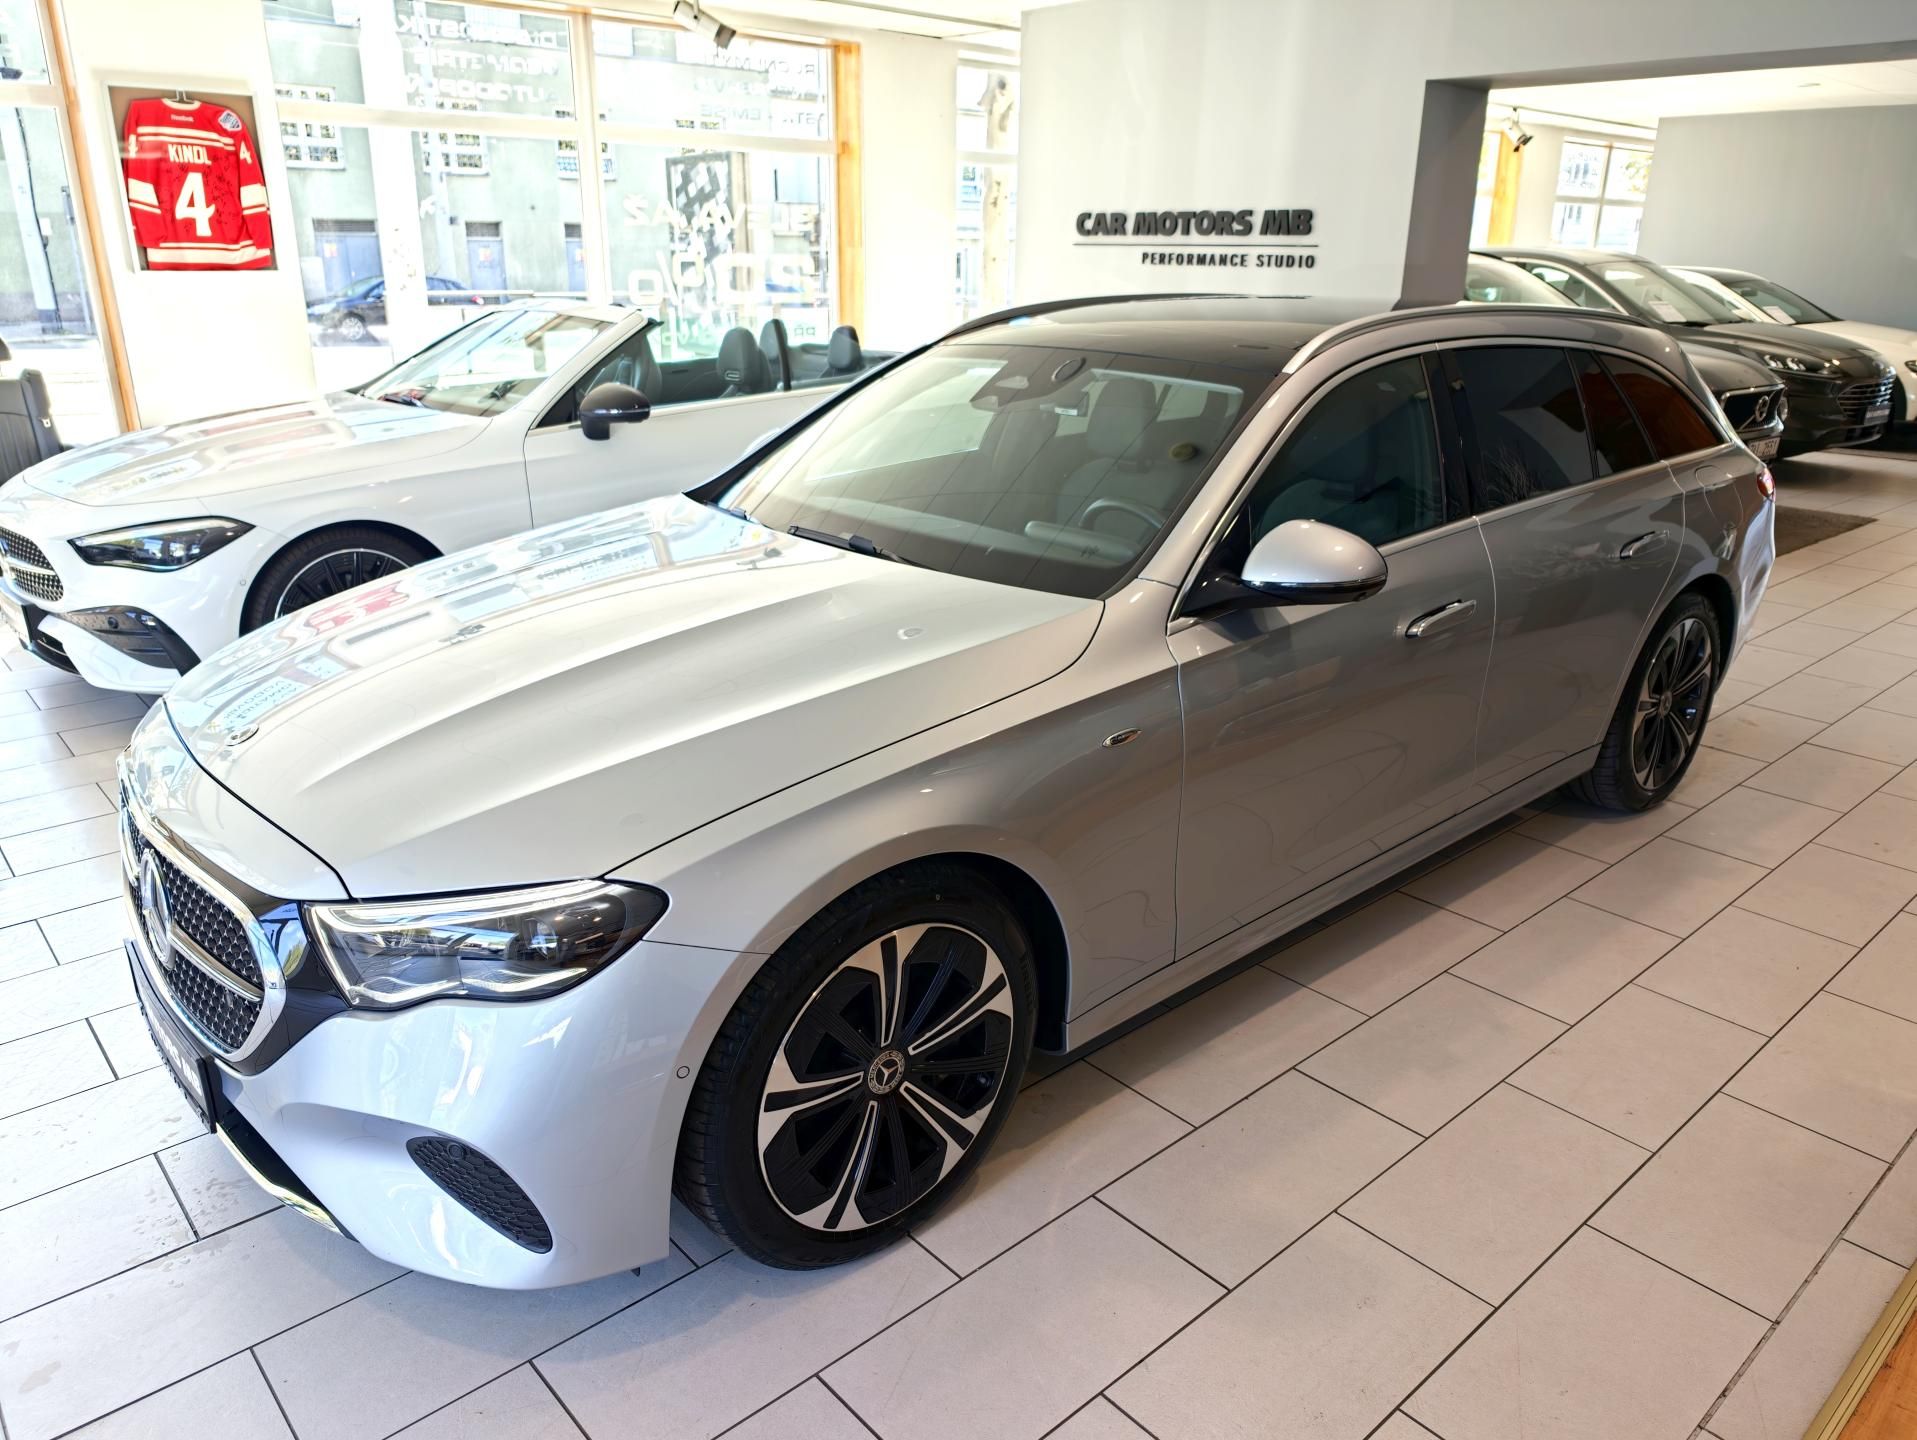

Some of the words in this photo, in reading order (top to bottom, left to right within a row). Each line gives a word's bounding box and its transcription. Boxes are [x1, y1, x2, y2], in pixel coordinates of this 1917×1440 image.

[168, 143, 212, 165] KINDL
[240, 141, 252, 164] 4
[175, 171, 215, 237] 4
[1075, 211, 1128, 236] CAR
[1131, 209, 1254, 237] MOTORS
[1259, 208, 1314, 236] MB
[1141, 251, 1249, 268] PERFORMANCE
[1255, 253, 1316, 269] STUDIO
